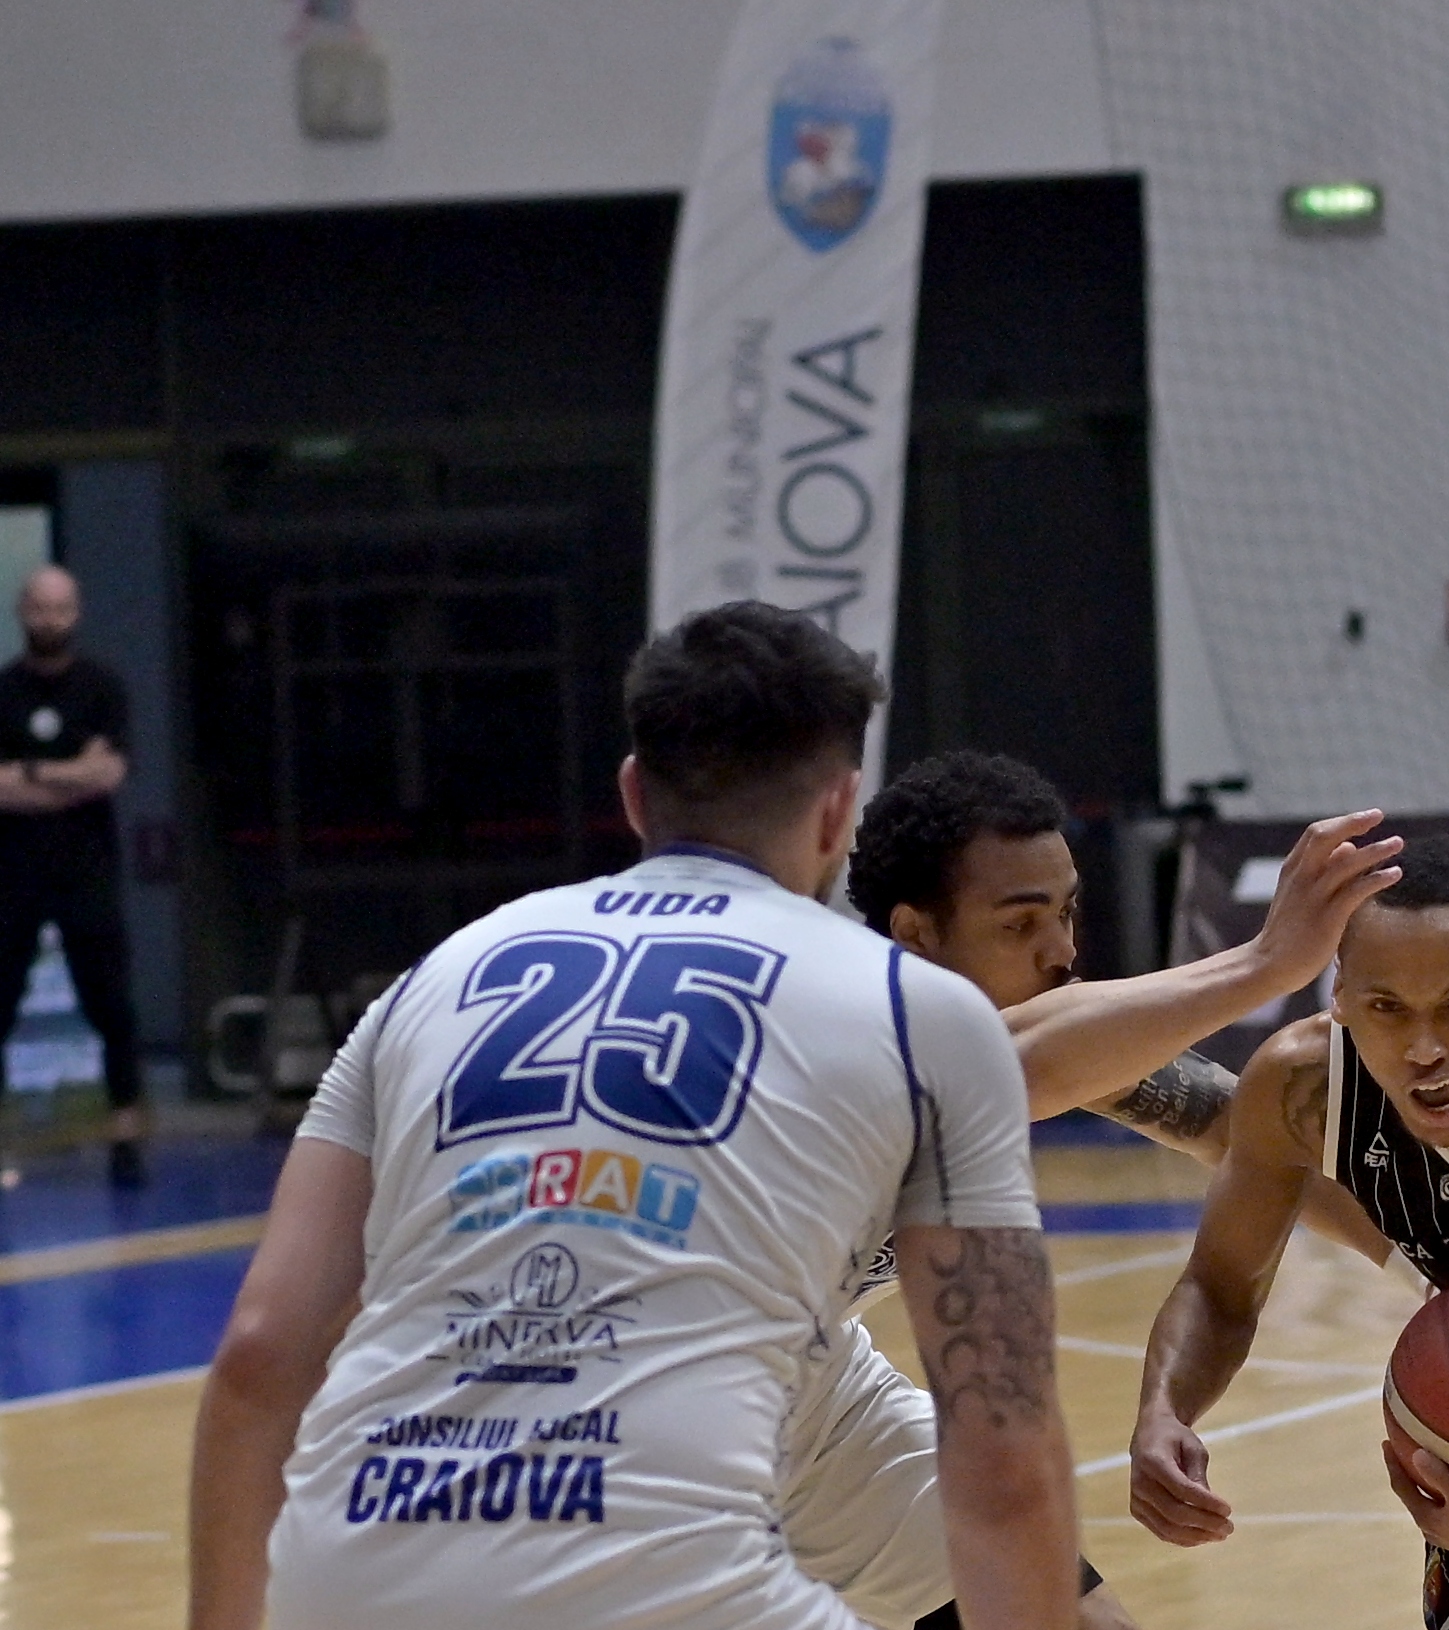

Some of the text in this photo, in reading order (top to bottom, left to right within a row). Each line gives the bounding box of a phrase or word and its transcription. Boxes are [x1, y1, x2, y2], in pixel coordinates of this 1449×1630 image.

[594, 890, 731, 916] VIDA
[435, 930, 788, 1153] 25
[1363, 1151, 1389, 1173] PEA
[347, 1453, 605, 1523] CRAIOVA
